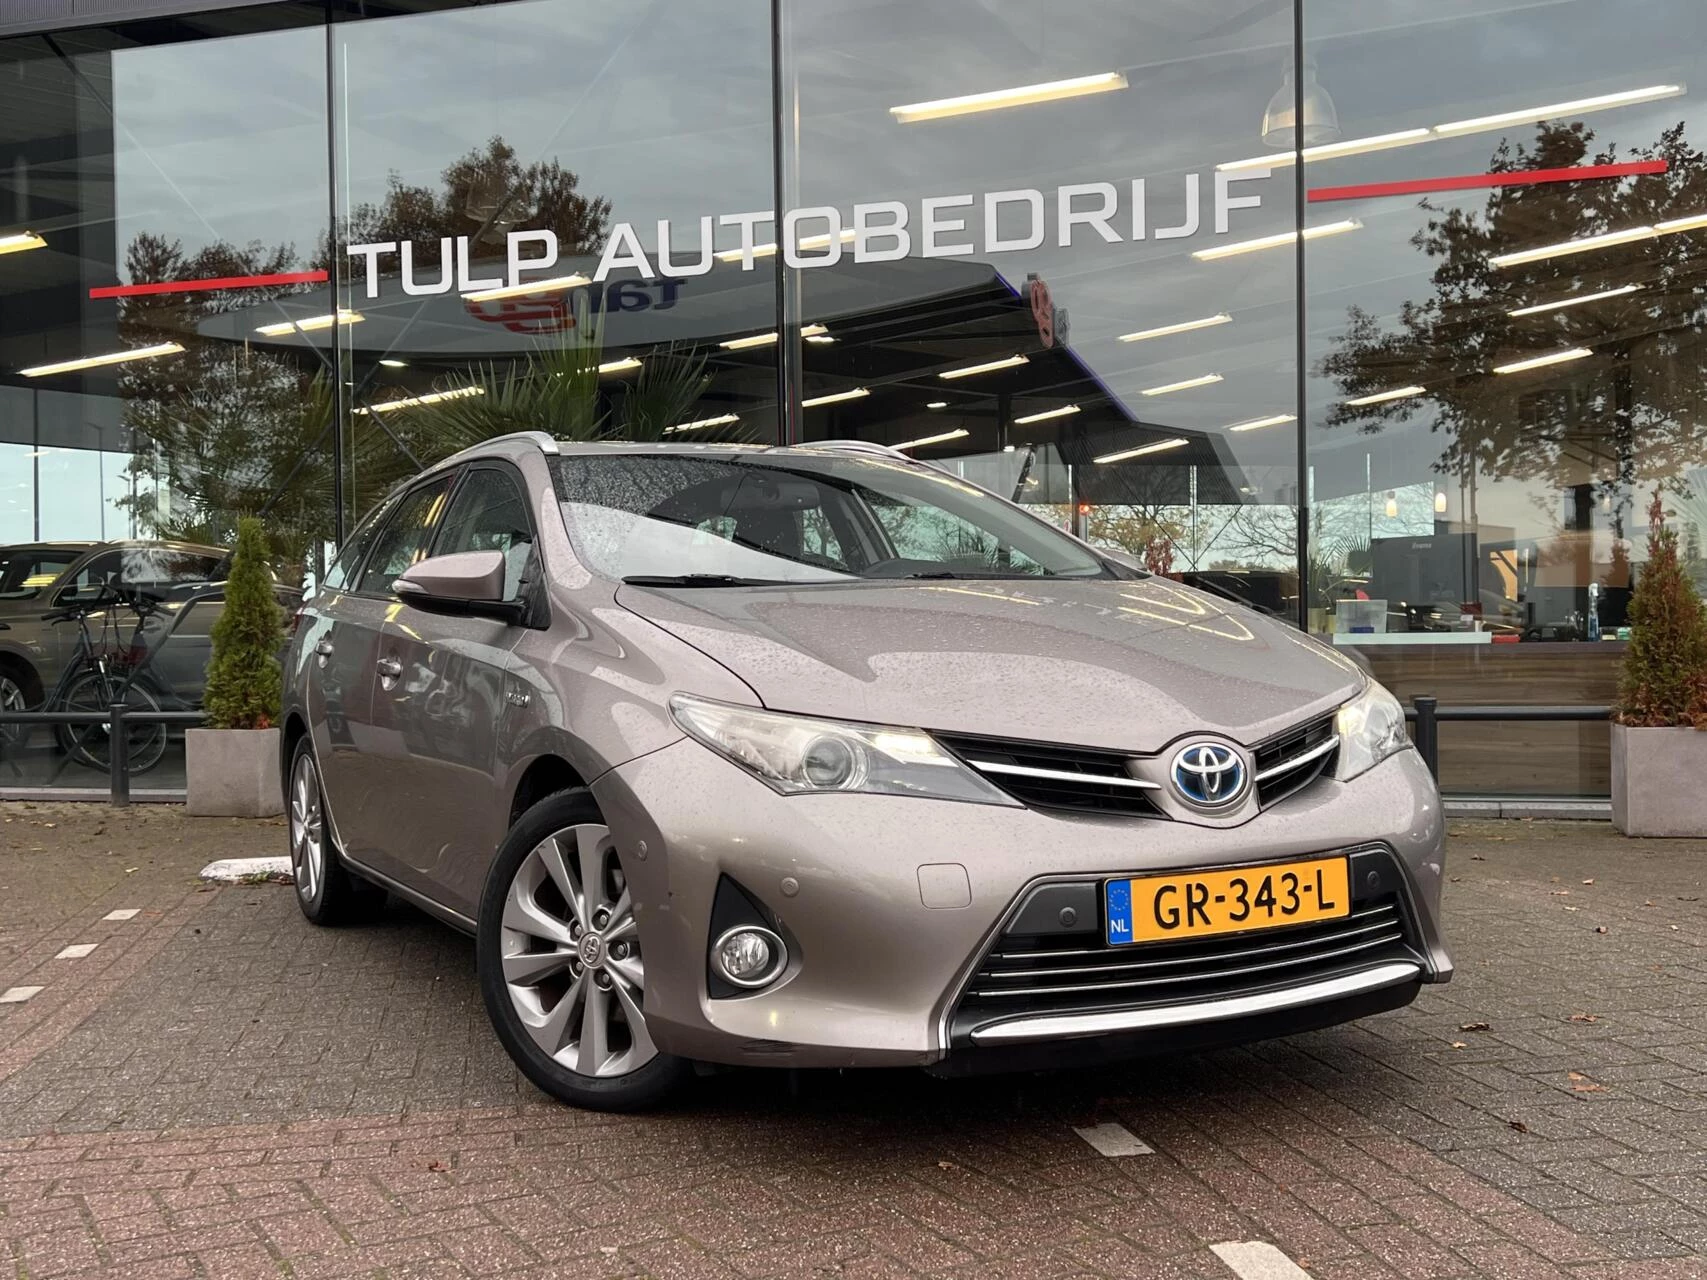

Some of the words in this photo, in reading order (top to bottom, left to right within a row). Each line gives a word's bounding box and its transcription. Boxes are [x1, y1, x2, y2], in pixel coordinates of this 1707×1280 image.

[346, 229, 558, 298] TULP
[592, 168, 1272, 282] AUTOBEDRIJF
[1110, 918, 1129, 934] NL
[1153, 869, 1335, 930] GR-343-L
